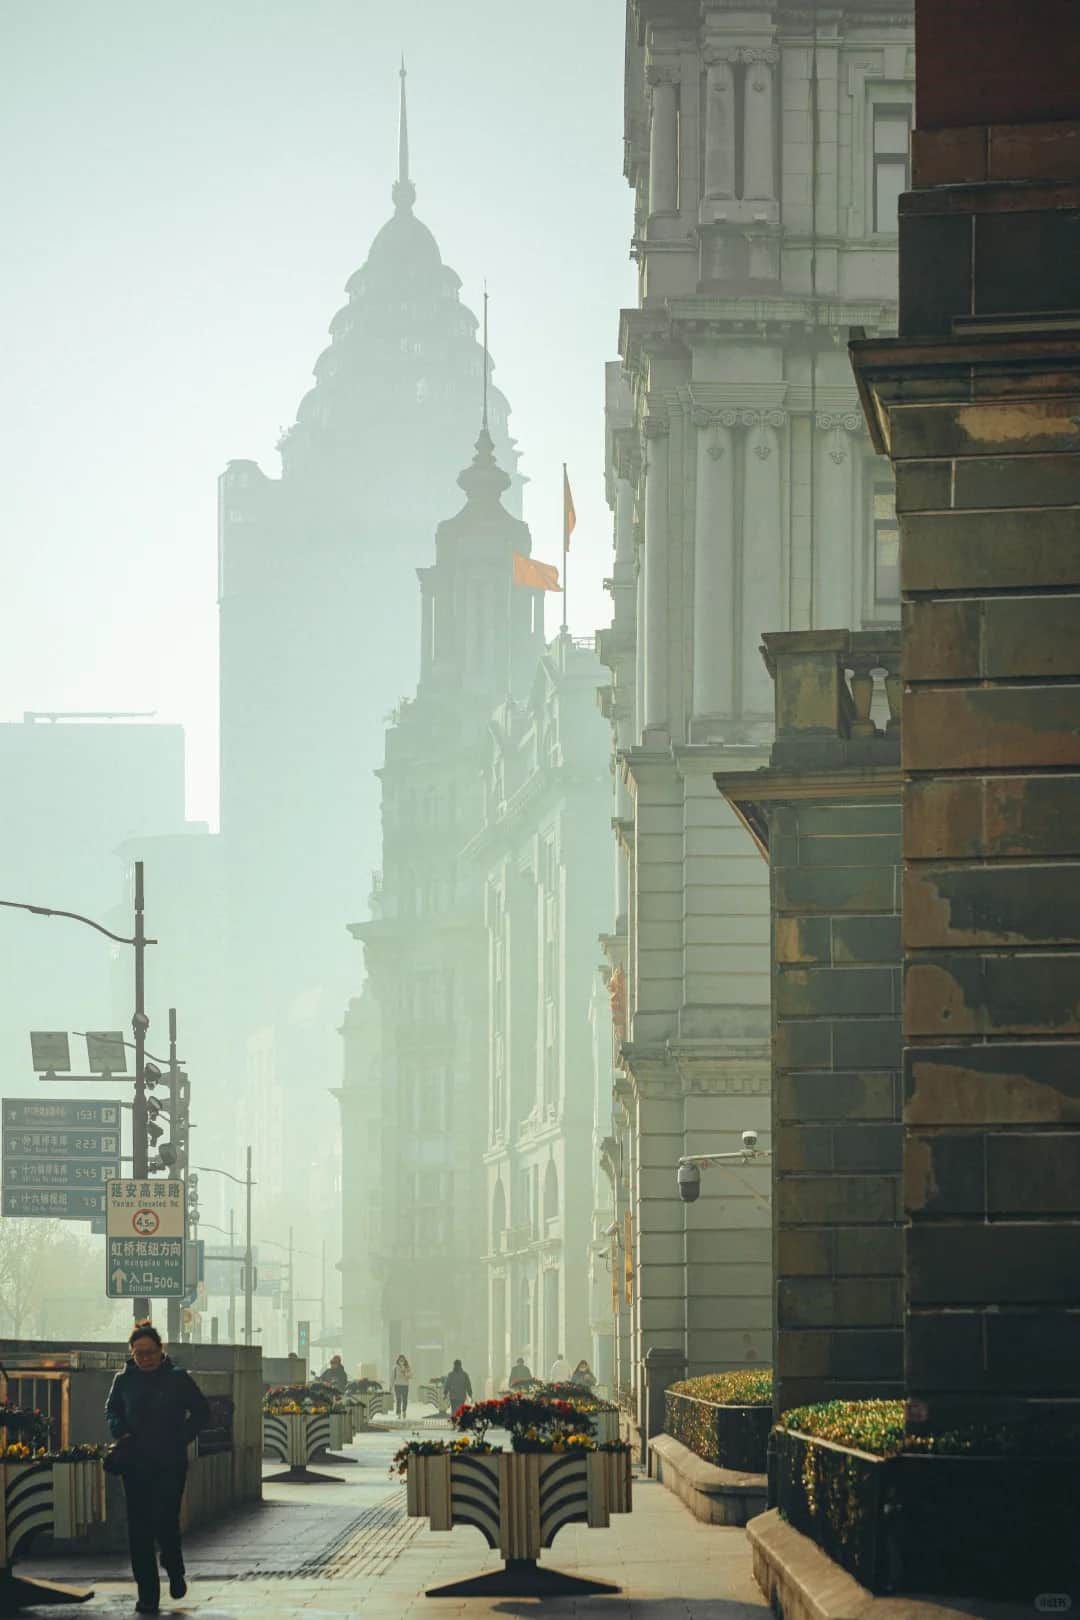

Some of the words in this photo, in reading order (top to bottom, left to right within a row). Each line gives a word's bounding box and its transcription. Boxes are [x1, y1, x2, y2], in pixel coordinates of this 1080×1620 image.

[111, 1182, 180, 1198] 延安高架路
[111, 1241, 181, 1257] 虹桥枢纽方向
[129, 1272, 153, 1284] 入口
